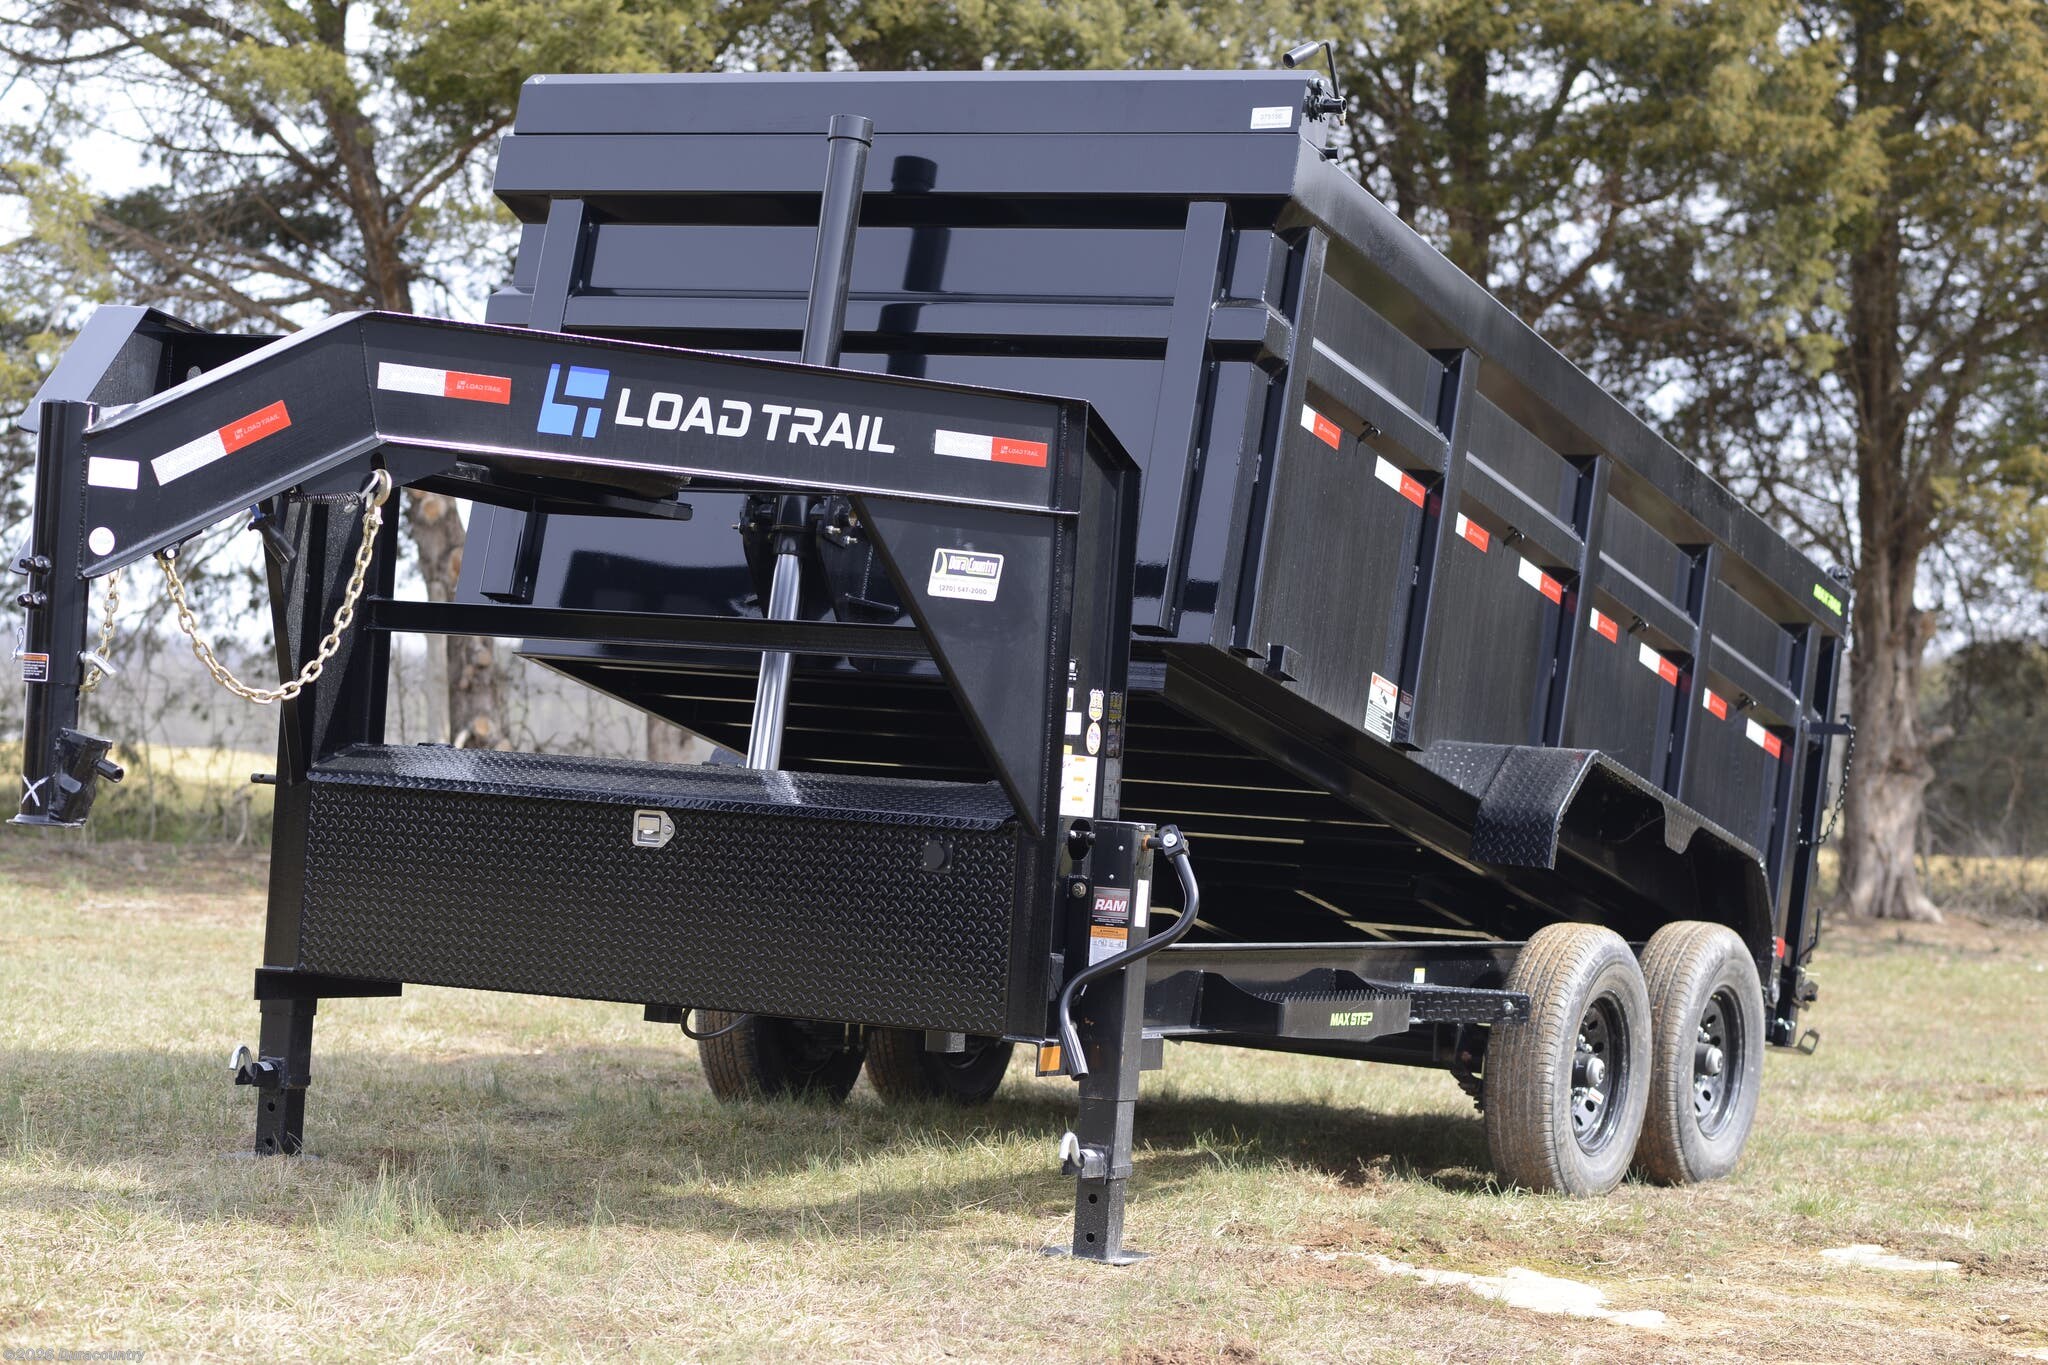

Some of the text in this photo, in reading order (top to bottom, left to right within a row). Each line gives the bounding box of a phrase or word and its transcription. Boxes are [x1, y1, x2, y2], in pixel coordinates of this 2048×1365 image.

[243, 413, 280, 434] LOAD TRAIL
[615, 388, 752, 438] LOAD
[761, 403, 895, 454] TRAIL
[1094, 898, 1127, 912] RAM
[1330, 1012, 1373, 1026] MAX STEP
